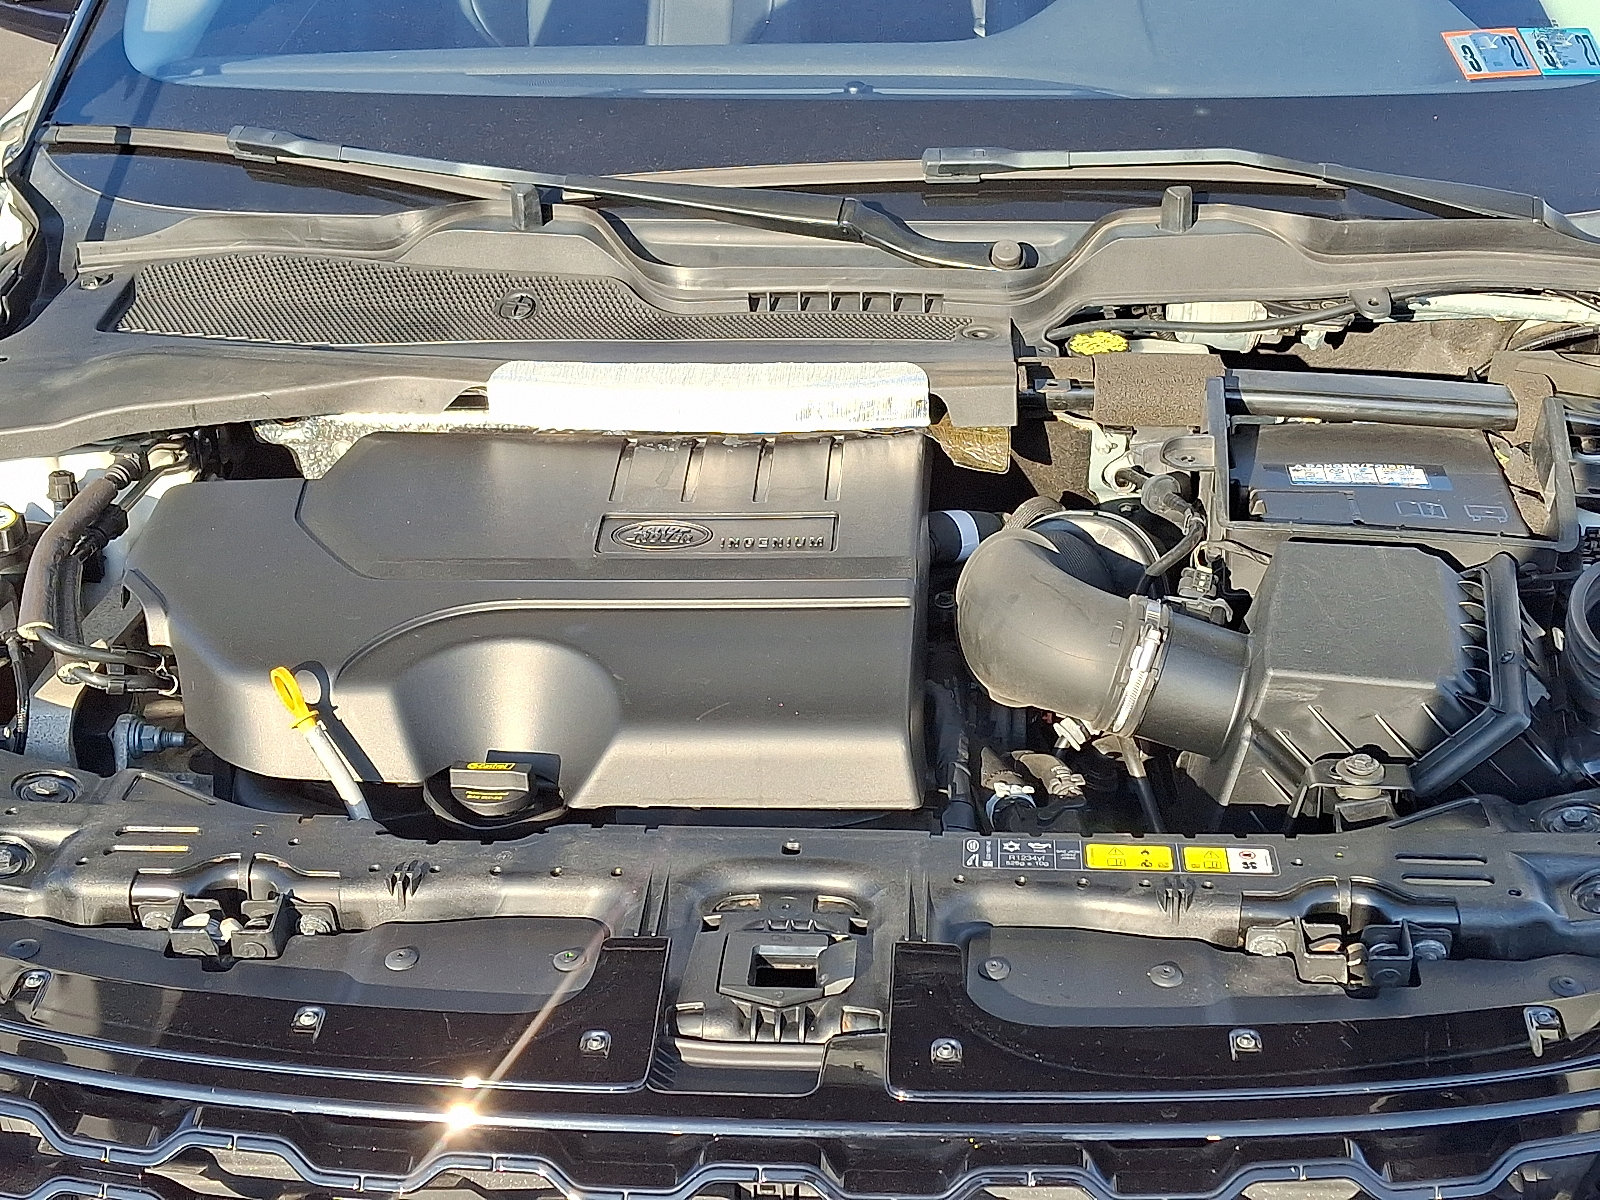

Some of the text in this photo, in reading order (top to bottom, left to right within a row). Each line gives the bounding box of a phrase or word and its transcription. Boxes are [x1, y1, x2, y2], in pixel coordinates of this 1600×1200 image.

[1461, 35, 1530, 72] 3 27
[1536, 34, 1600, 68] 3 27
[719, 536, 824, 549] INGENIUM
